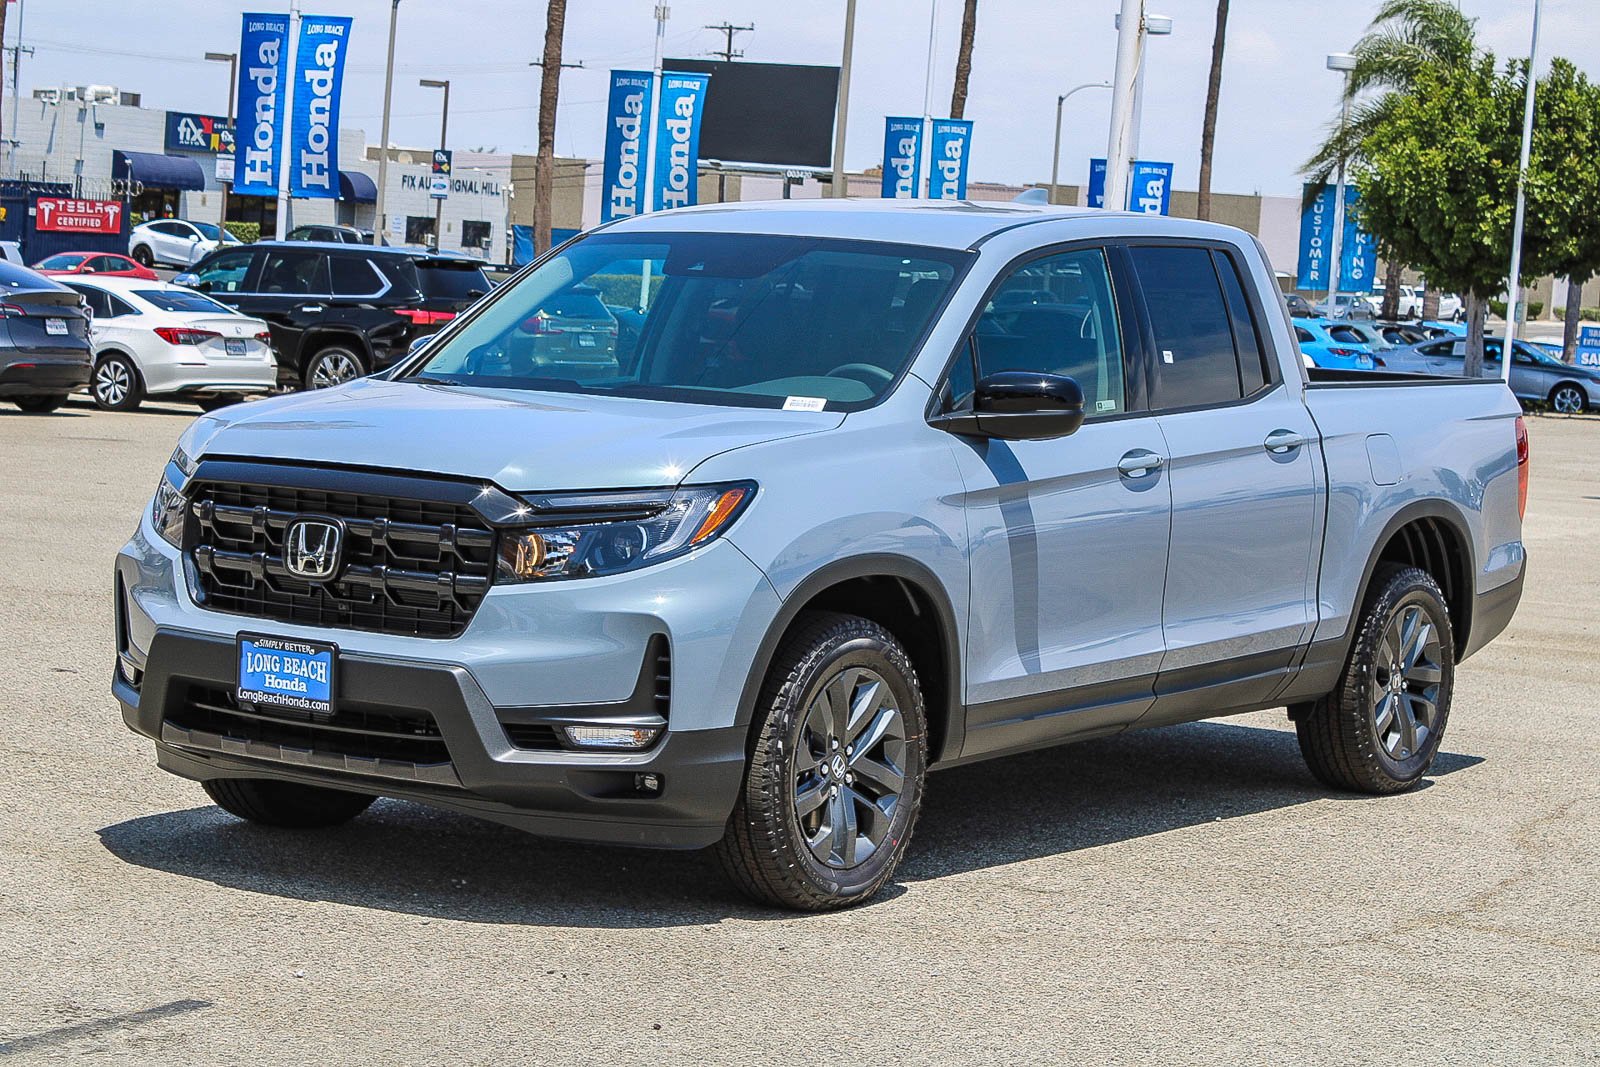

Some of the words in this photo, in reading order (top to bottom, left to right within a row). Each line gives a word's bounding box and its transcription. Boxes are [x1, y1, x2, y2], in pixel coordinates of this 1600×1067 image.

[249, 22, 264, 32] LONG
[266, 23, 284, 33] BEACH
[307, 24, 323, 34] LONG
[324, 25, 344, 36] BEACH
[244, 38, 280, 186] Honda
[301, 40, 338, 189] Honda
[610, 92, 644, 218] Honda
[662, 94, 696, 210] Honda
[891, 135, 917, 198] nda
[938, 138, 964, 199] nda
[402, 175, 416, 190] FIX
[418, 177, 432, 190] AU
[481, 182, 500, 195] HILL
[57, 200, 103, 214] TESLA
[57, 217, 101, 227] CERTIFIED
[259, 639, 283, 650] SIMPLY
[284, 642, 311, 653] BETTER
[246, 652, 280, 673] LONG
[283, 657, 327, 683] BEACH
[264, 673, 307, 692] Honda
[238, 687, 330, 711] LongBeachHonda.com
